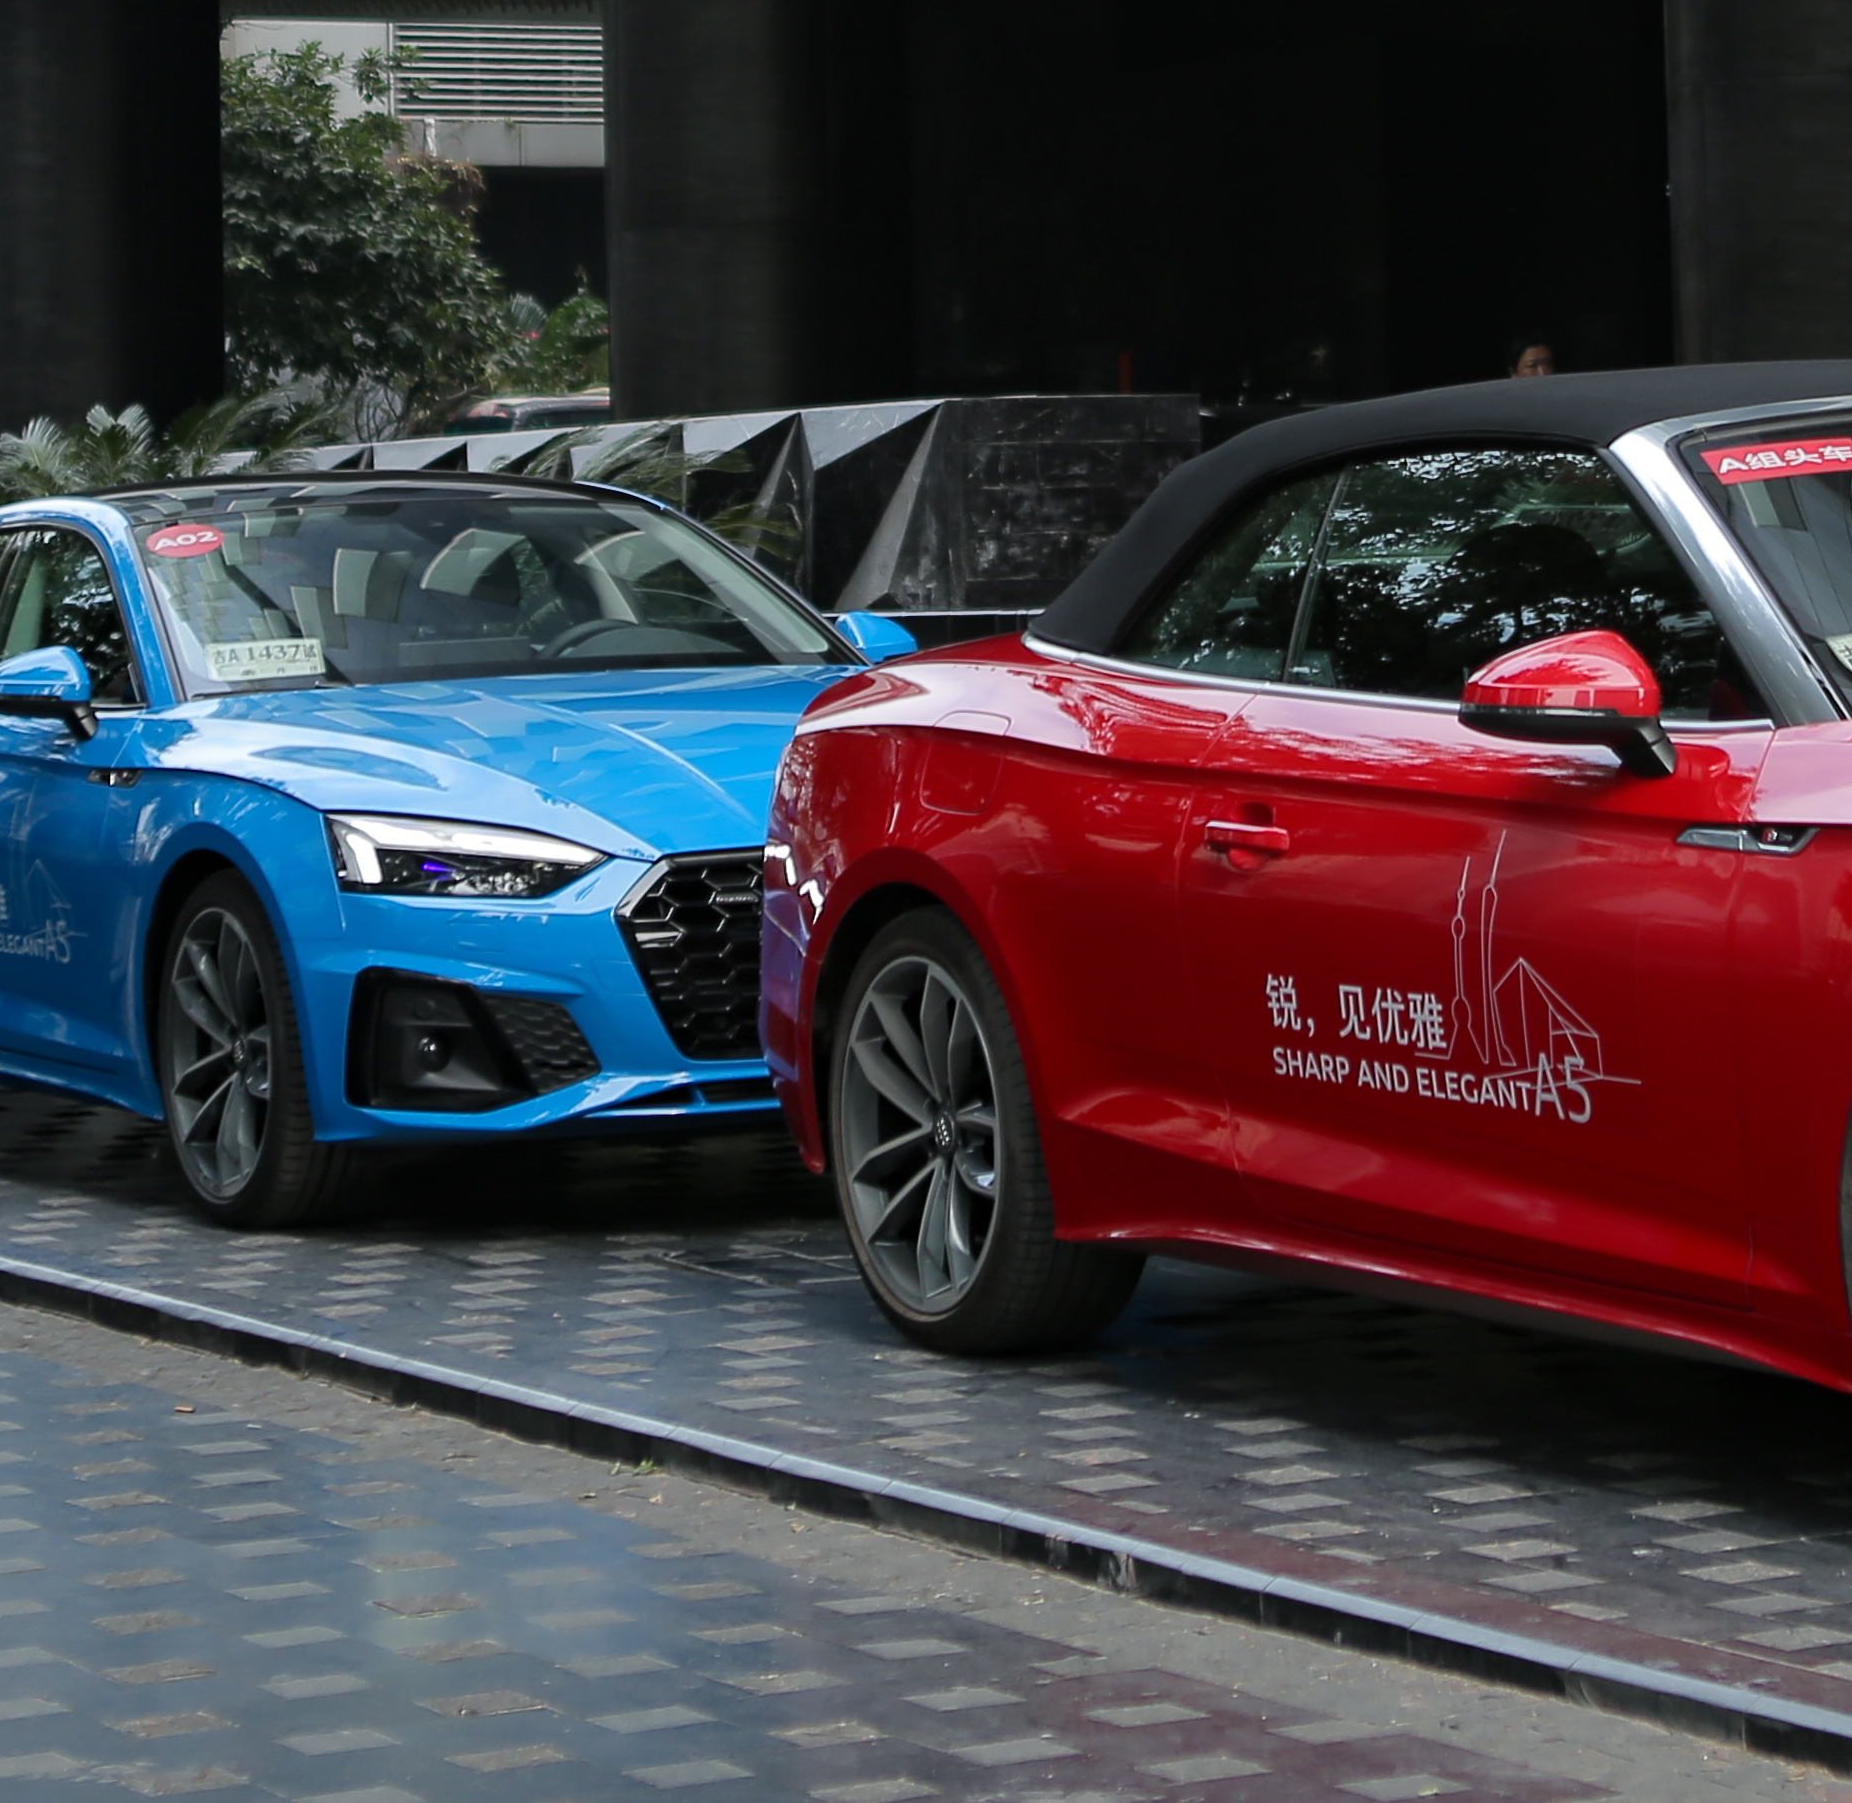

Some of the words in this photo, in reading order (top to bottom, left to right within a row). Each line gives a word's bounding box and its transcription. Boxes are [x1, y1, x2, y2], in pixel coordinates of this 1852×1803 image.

[154, 530, 218, 551] A02
[1272, 1047, 1350, 1083] SHARP
[1358, 1060, 1409, 1092] AND
[1416, 1067, 1531, 1111] ELEGANT
